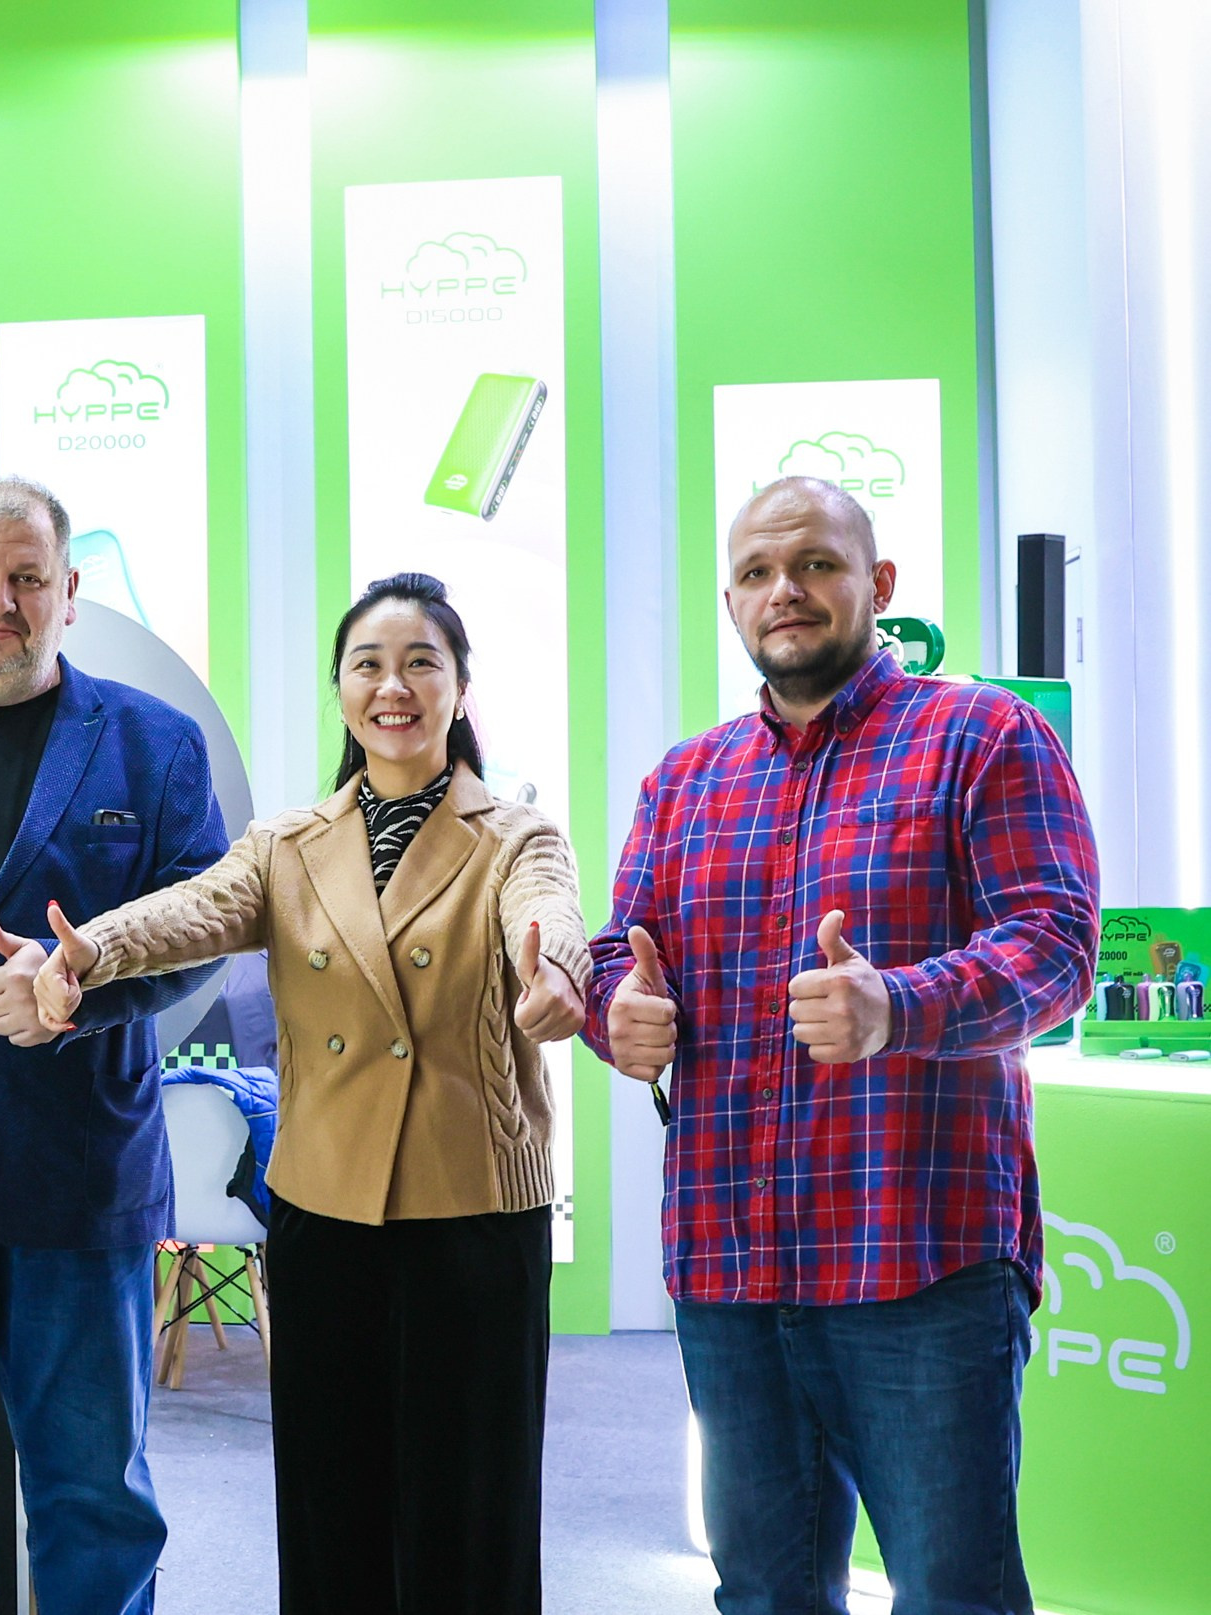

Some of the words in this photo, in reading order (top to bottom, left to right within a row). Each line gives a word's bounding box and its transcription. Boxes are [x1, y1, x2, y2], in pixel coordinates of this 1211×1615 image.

[380, 276, 517, 300] HYPPE
[34, 402, 160, 424] HYPPE
[58, 433, 146, 451] D20000
